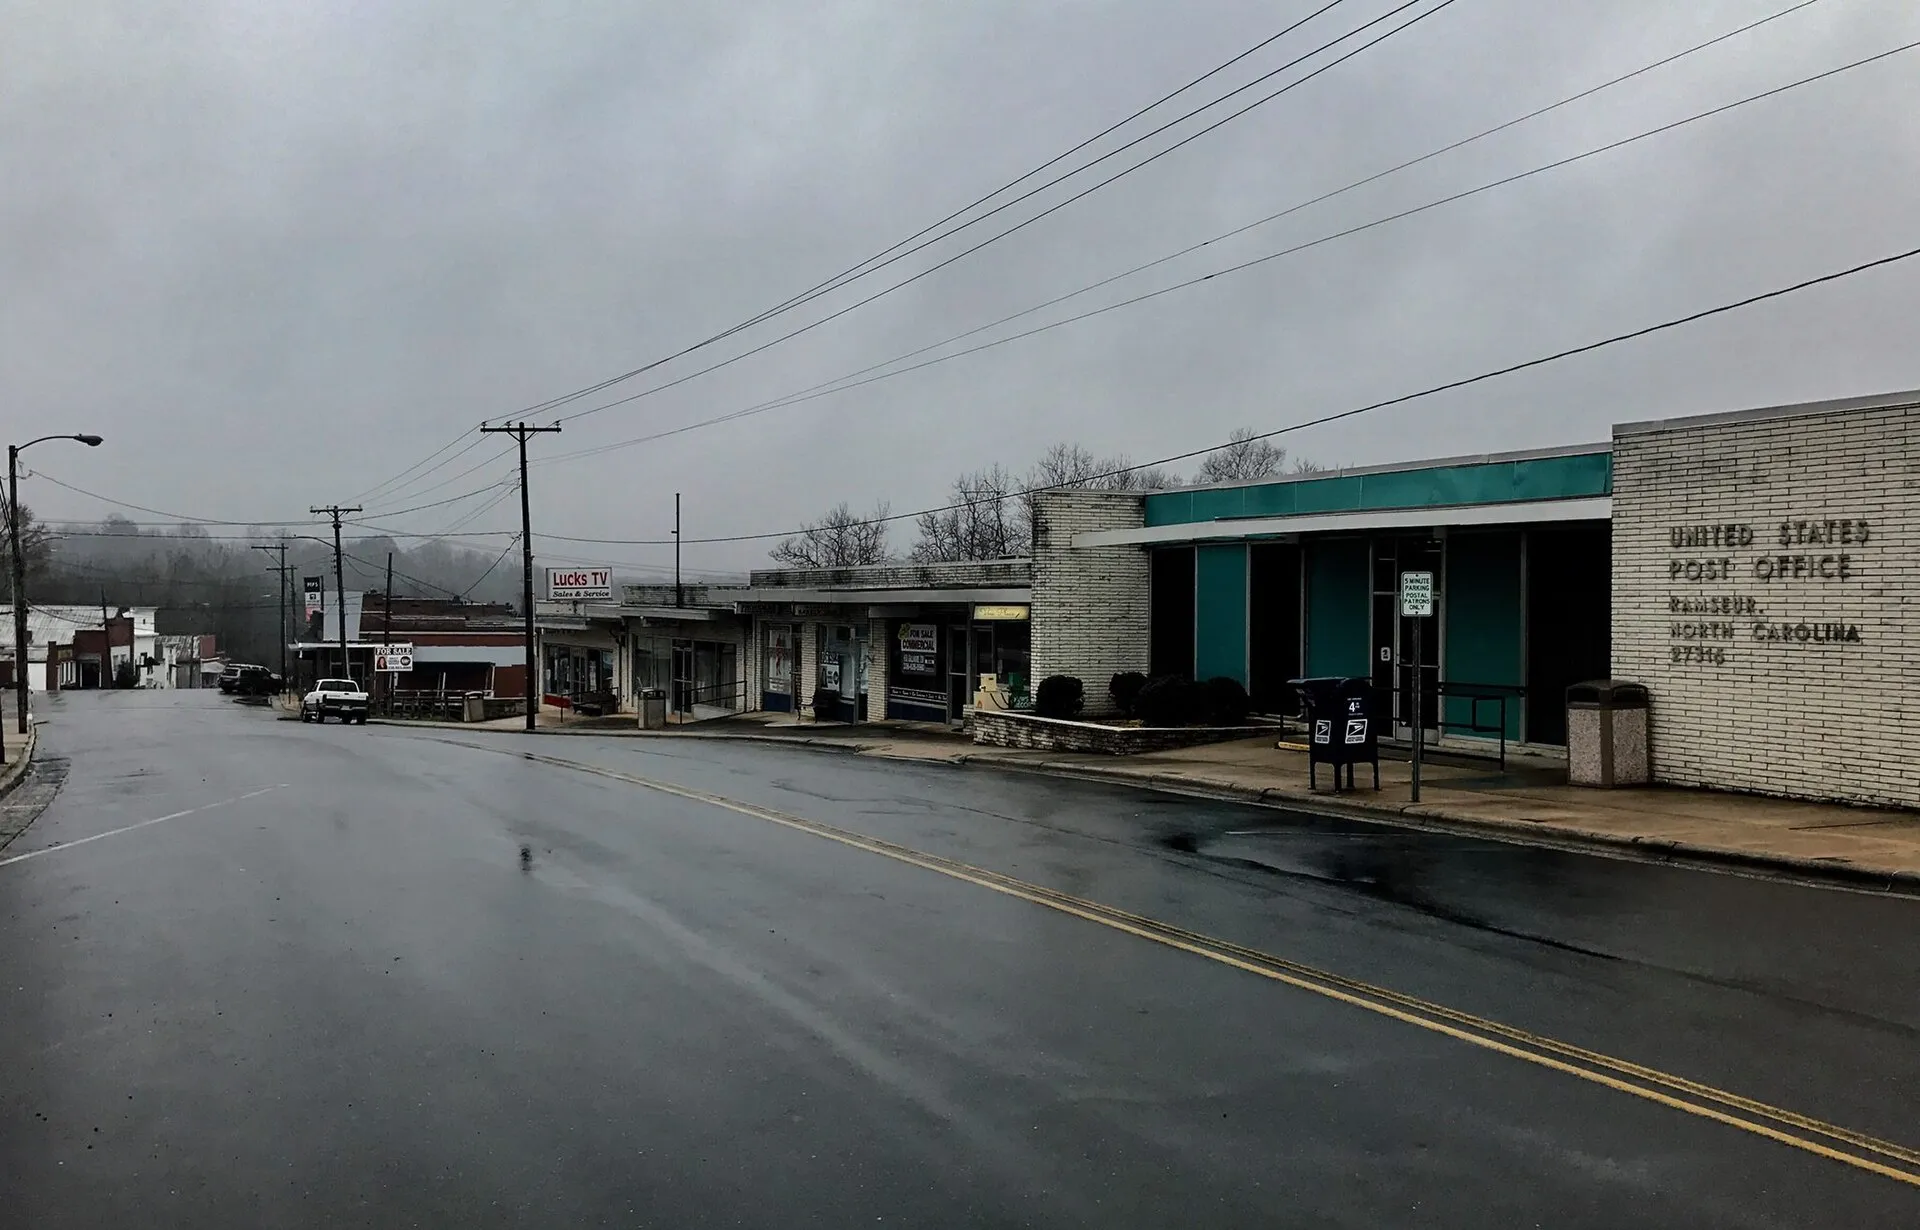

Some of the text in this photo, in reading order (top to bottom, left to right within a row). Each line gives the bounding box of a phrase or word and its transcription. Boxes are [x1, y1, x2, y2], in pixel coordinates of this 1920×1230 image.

[1669, 519, 1870, 548] UNITED STATES
[1669, 554, 1851, 580] POST OFFICE
[553, 572, 608, 586] Lucks TV
[921, 630, 934, 638] SALE
[1669, 622, 1861, 643] NORTH CAROLINA
[903, 639, 935, 650] COMMERCIAL
[1670, 646, 1725, 665] 27316
